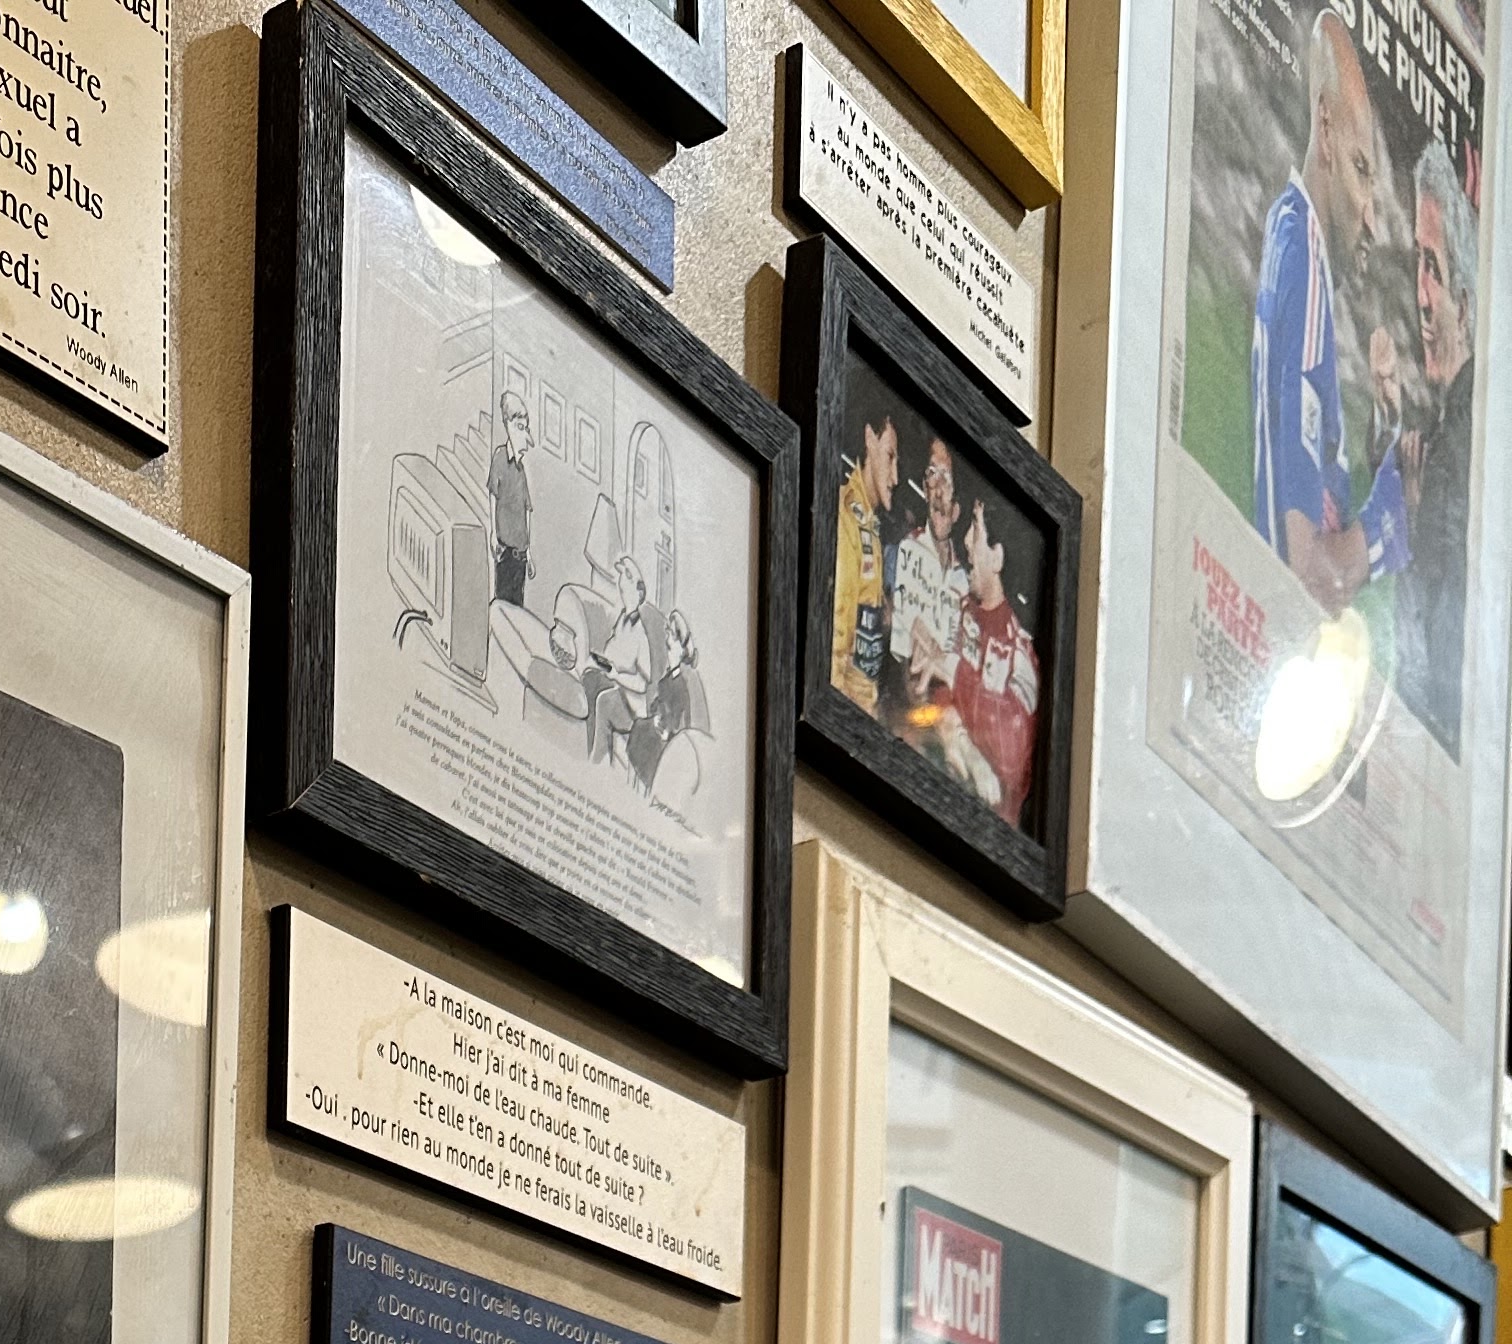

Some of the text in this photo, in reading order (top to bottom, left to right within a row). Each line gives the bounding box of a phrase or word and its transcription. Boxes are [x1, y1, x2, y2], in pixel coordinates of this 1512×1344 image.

[1362, 0, 1458, 159] DE PUTE !
[66, 115, 82, 147] a
[46, 163, 102, 220] plus
[827, 80, 1012, 286] Il n'y a pas homme plus courageux
[50, 282, 104, 339] soir.
[66, 334, 138, 393] Woody Allen
[424, 981, 436, 1008] la
[441, 995, 492, 1035] maison
[496, 1019, 526, 1051] c'est
[530, 1038, 554, 1063] moi
[558, 1051, 578, 1075] qui
[582, 1063, 652, 1110] commande.
[453, 1032, 610, 1124] Hier j'ai dit à ma femme
[347, 1243, 376, 1271] Une
[380, 1254, 404, 1280] fille
[408, 1267, 456, 1298] sussure
[460, 1284, 471, 1305] à
[523, 1307, 542, 1328] de
[918, 1223, 999, 1343] MATCH
